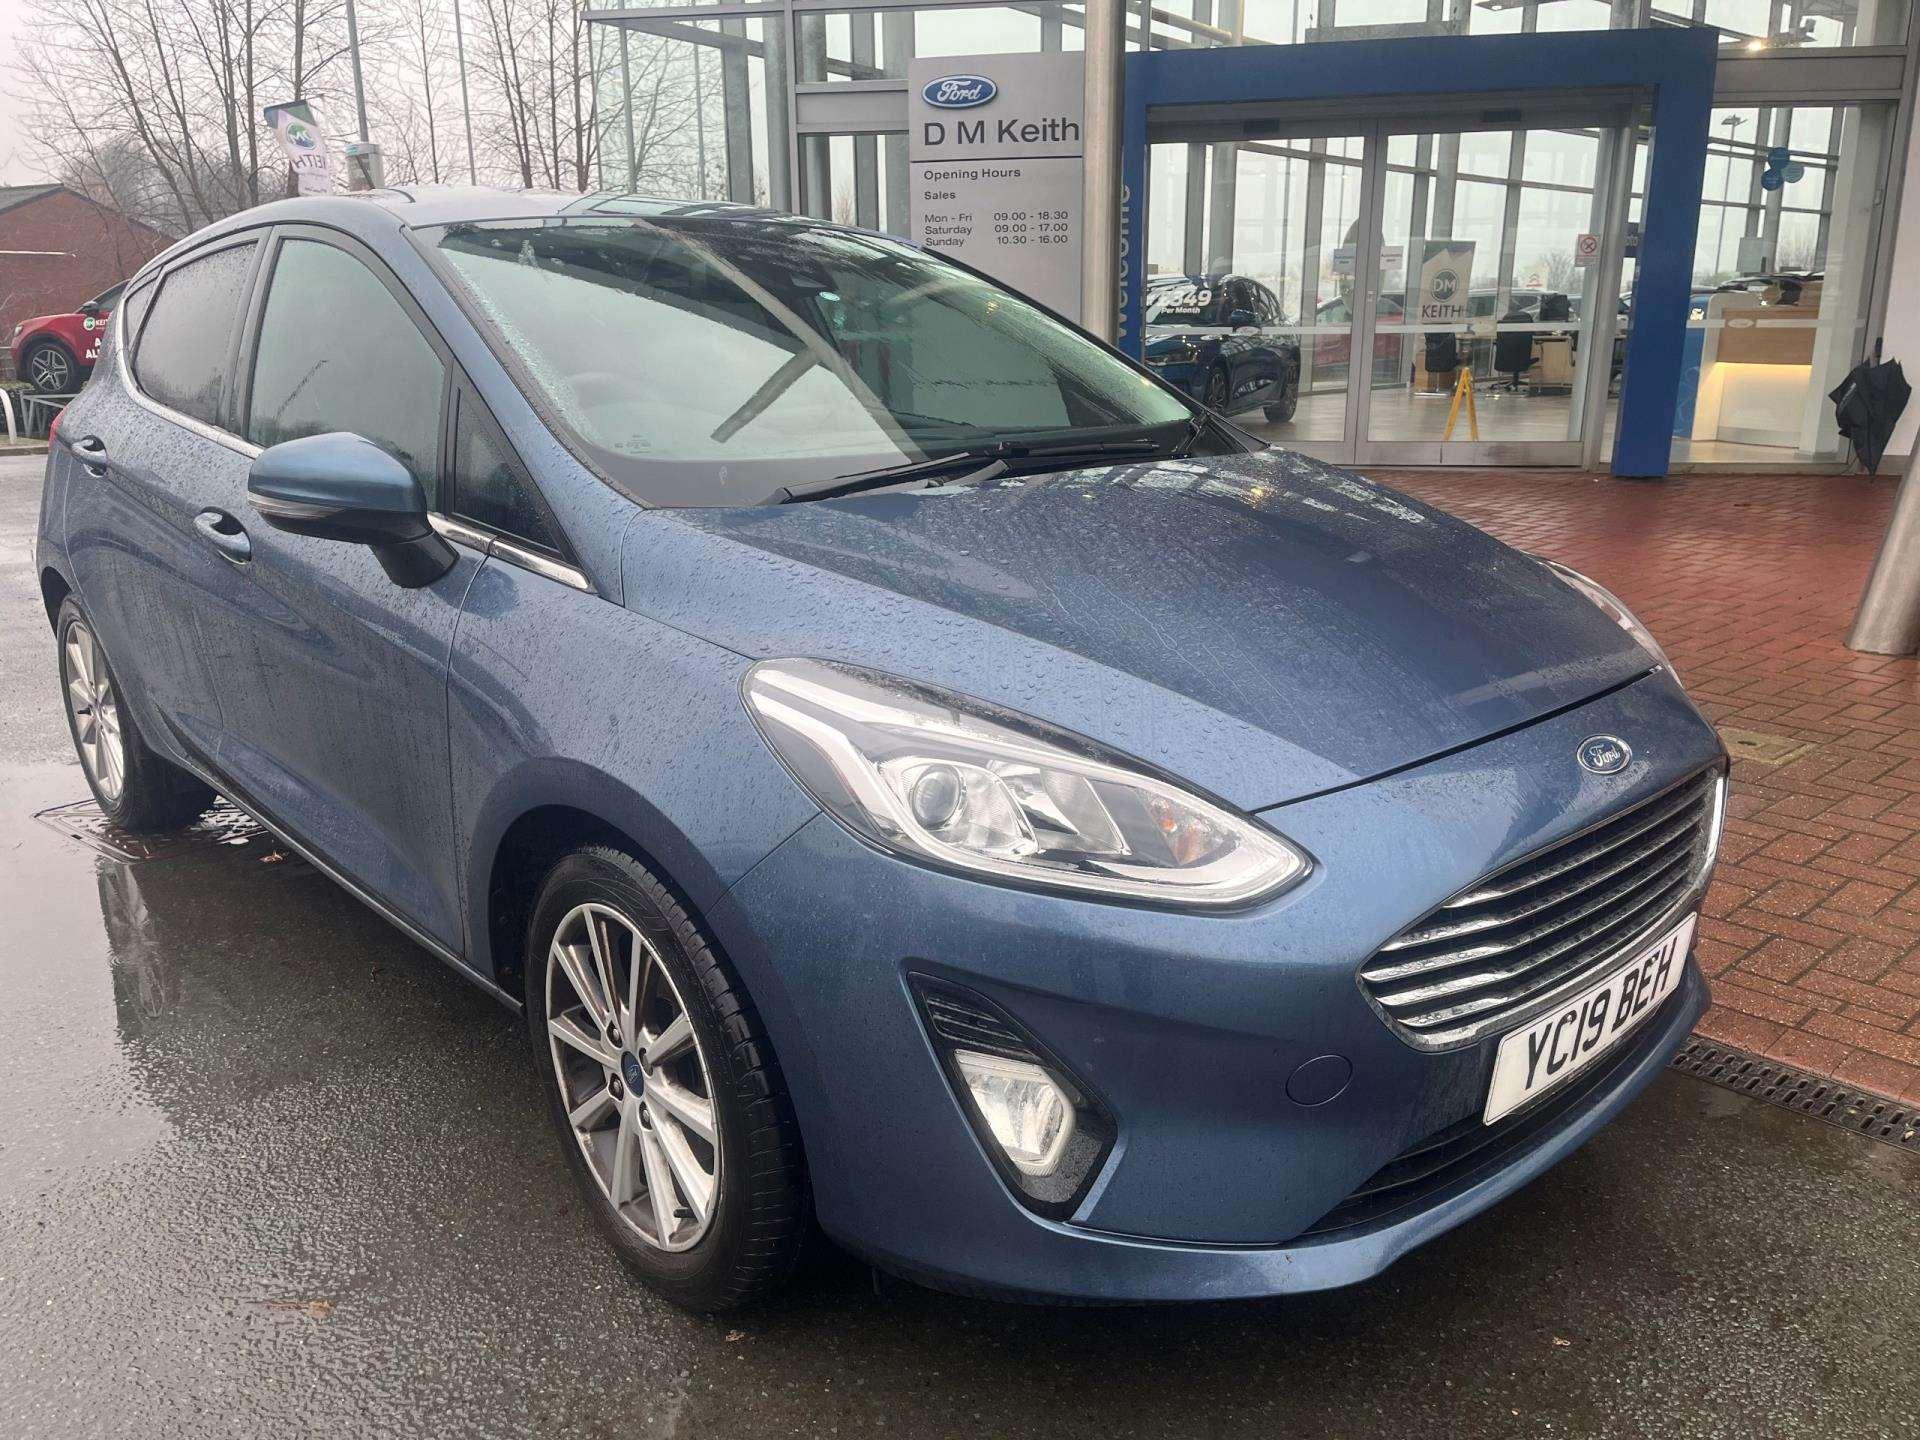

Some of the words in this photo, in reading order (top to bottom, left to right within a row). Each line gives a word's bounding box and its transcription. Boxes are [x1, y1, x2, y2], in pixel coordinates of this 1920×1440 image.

[936, 79, 982, 102] Ford
[924, 122, 946, 146] D
[957, 120, 985, 145] M
[997, 117, 1080, 143] Keith
[924, 169, 979, 182] Opening
[981, 168, 1021, 179] Hours
[924, 190, 957, 200] Sales
[924, 213, 948, 223] Mon
[958, 212, 973, 222] Fri
[993, 212, 1026, 221] 09.00
[1038, 210, 1069, 220] 18.30
[924, 225, 973, 236] Saturday
[994, 223, 1027, 233] 09.00
[1038, 222, 1068, 232] 17.00
[926, 237, 965, 247] Sunday
[997, 235, 1027, 245] 10.30
[1038, 234, 1068, 244] 16.00
[1432, 278, 1456, 292] DM
[1175, 306, 1201, 314] Month
[1421, 304, 1462, 318] KEITH
[1589, 743, 1621, 767] Ford
[1525, 988, 1611, 1090] YC19
[1611, 936, 1678, 1033] BEH
